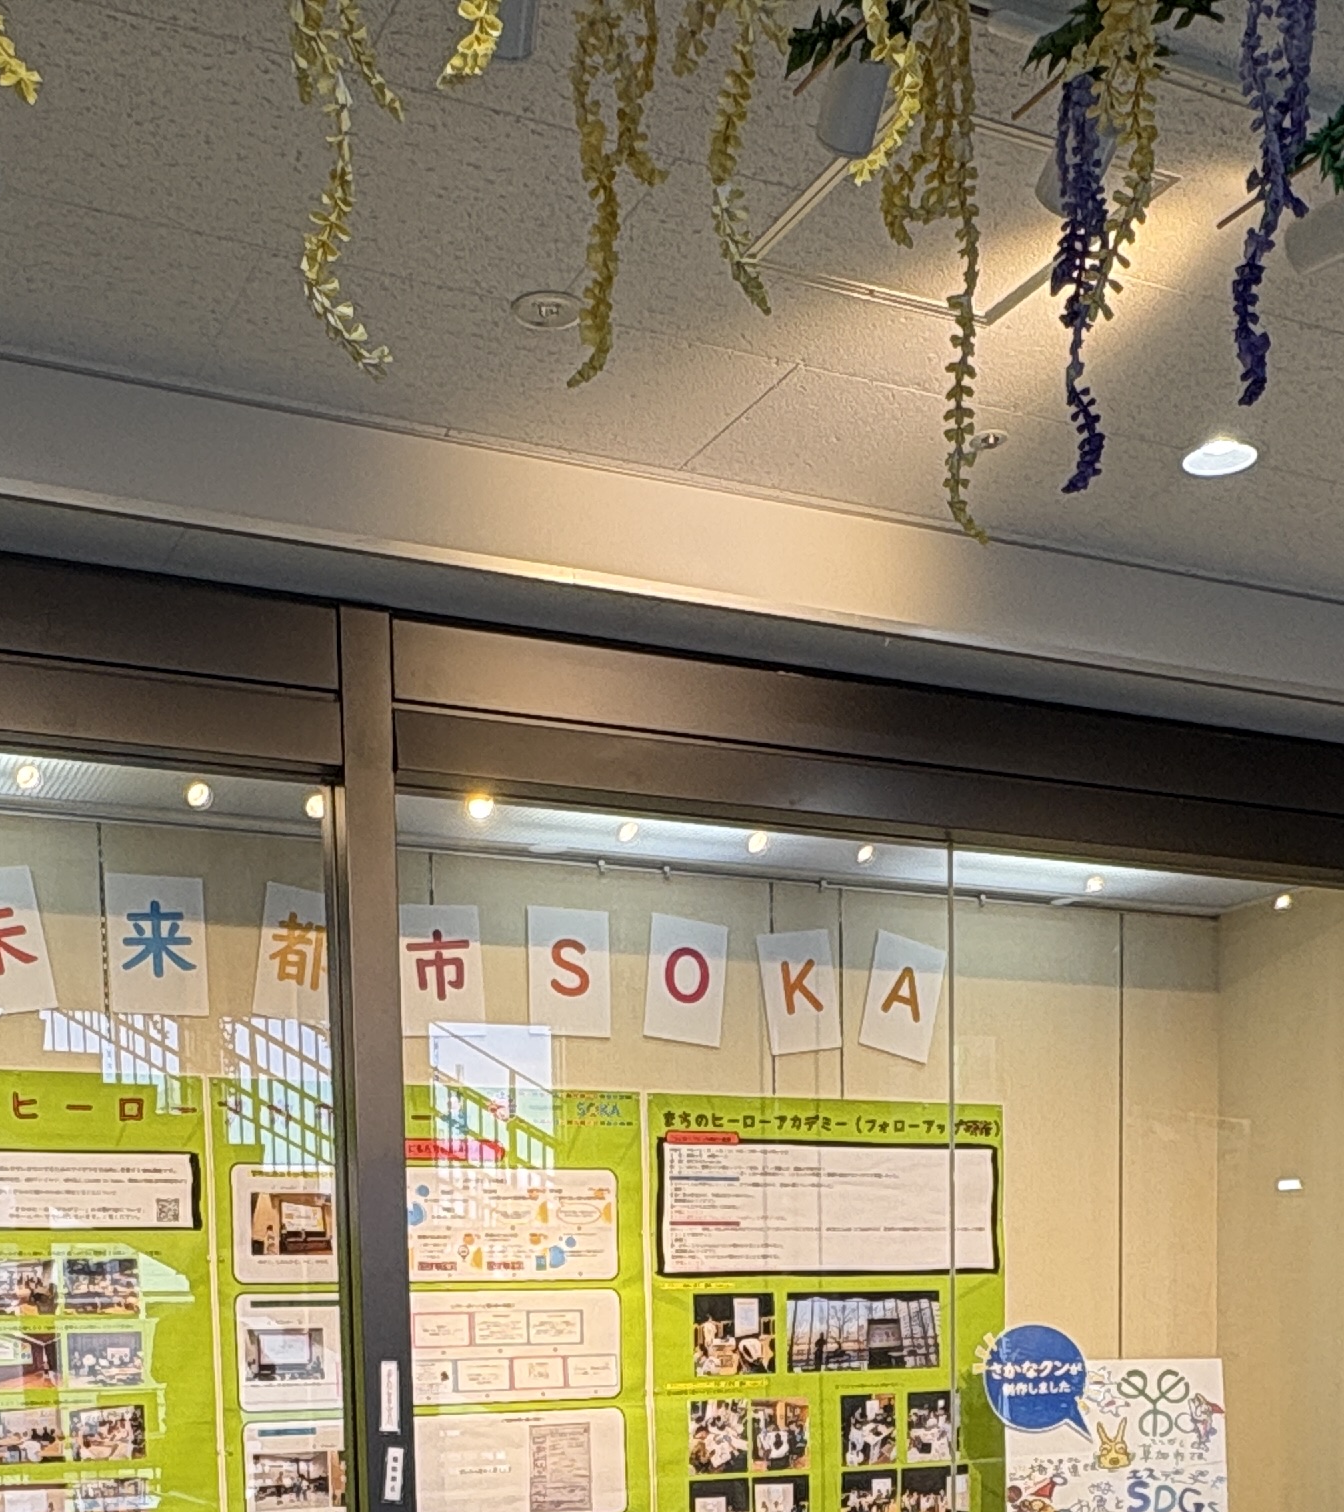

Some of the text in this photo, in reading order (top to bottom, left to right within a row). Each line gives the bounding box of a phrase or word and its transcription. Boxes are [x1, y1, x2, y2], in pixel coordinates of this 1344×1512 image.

[987, 1361, 1084, 1379] さかなクンが
